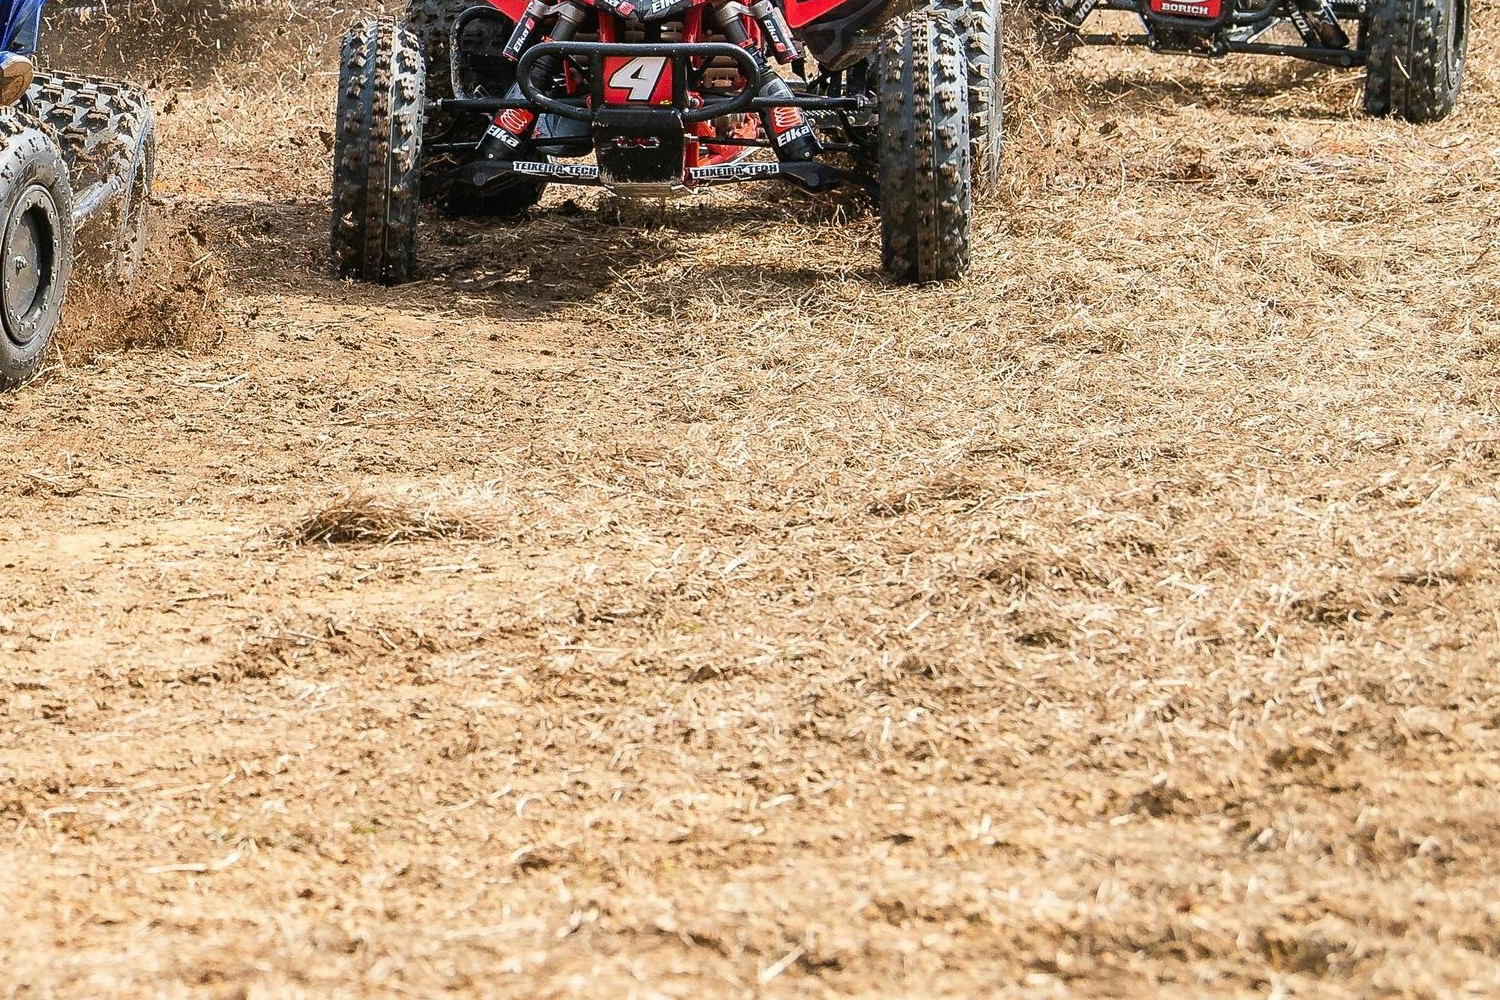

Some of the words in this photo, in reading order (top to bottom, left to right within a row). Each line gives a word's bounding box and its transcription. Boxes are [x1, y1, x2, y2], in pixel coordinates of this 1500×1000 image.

[1160, 2, 1209, 15] BORICH
[513, 27, 530, 53] Elka
[765, 18, 781, 44] Elka
[609, 56, 667, 101] 4
[486, 123, 519, 148] Elka
[777, 123, 811, 148] Elka
[566, 164, 599, 178] TECH
